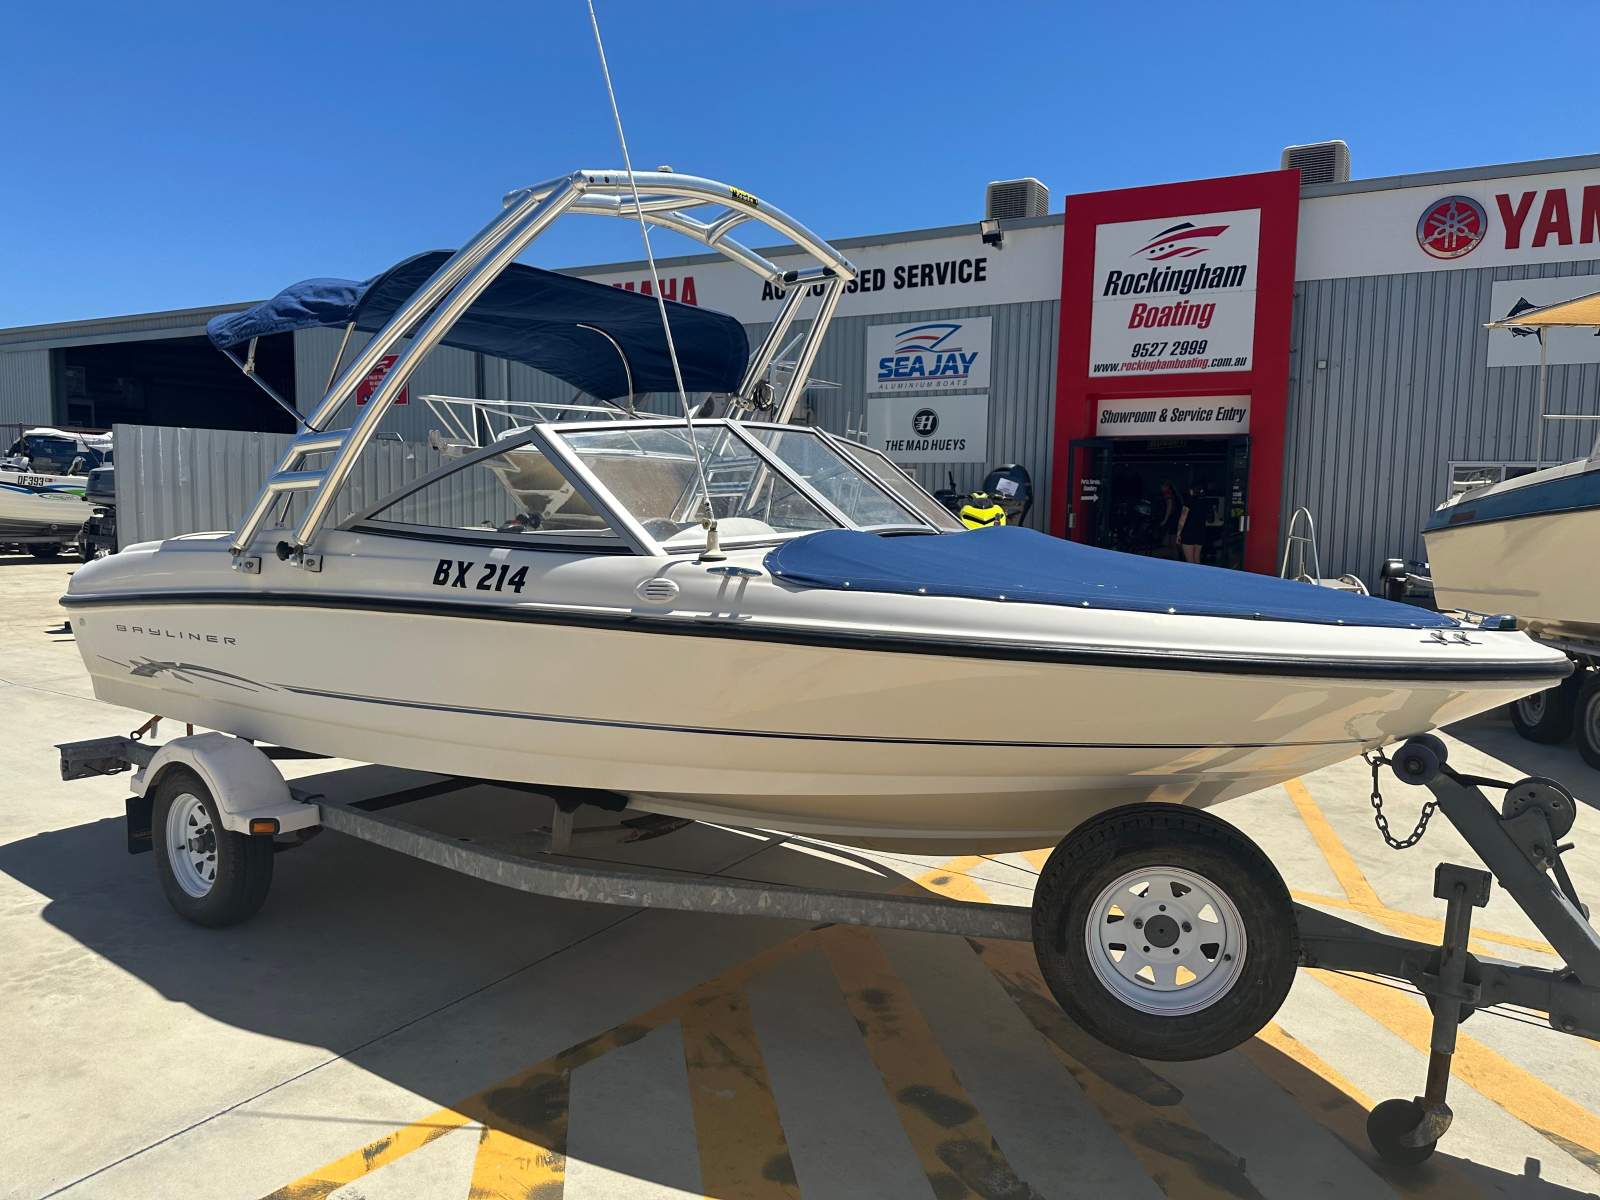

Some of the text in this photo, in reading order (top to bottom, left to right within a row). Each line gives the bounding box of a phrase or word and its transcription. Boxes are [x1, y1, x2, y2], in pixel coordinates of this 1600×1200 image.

[893, 258, 988, 290] SERVICE
[1103, 263, 1248, 296] Rockingham
[1128, 300, 1217, 329] Boating
[1131, 340, 1208, 358] 9527 2999
[878, 352, 979, 378] SEA JAY
[1093, 355, 1248, 373] www.rockinghamboating.com.au
[880, 383, 933, 391] ALUMINIUM
[1100, 406, 1247, 425] Showroom & Service Entry
[885, 438, 966, 451] THE MAD HUEYS
[433, 559, 530, 594] BX 214
[116, 624, 237, 646] BAYLINER
